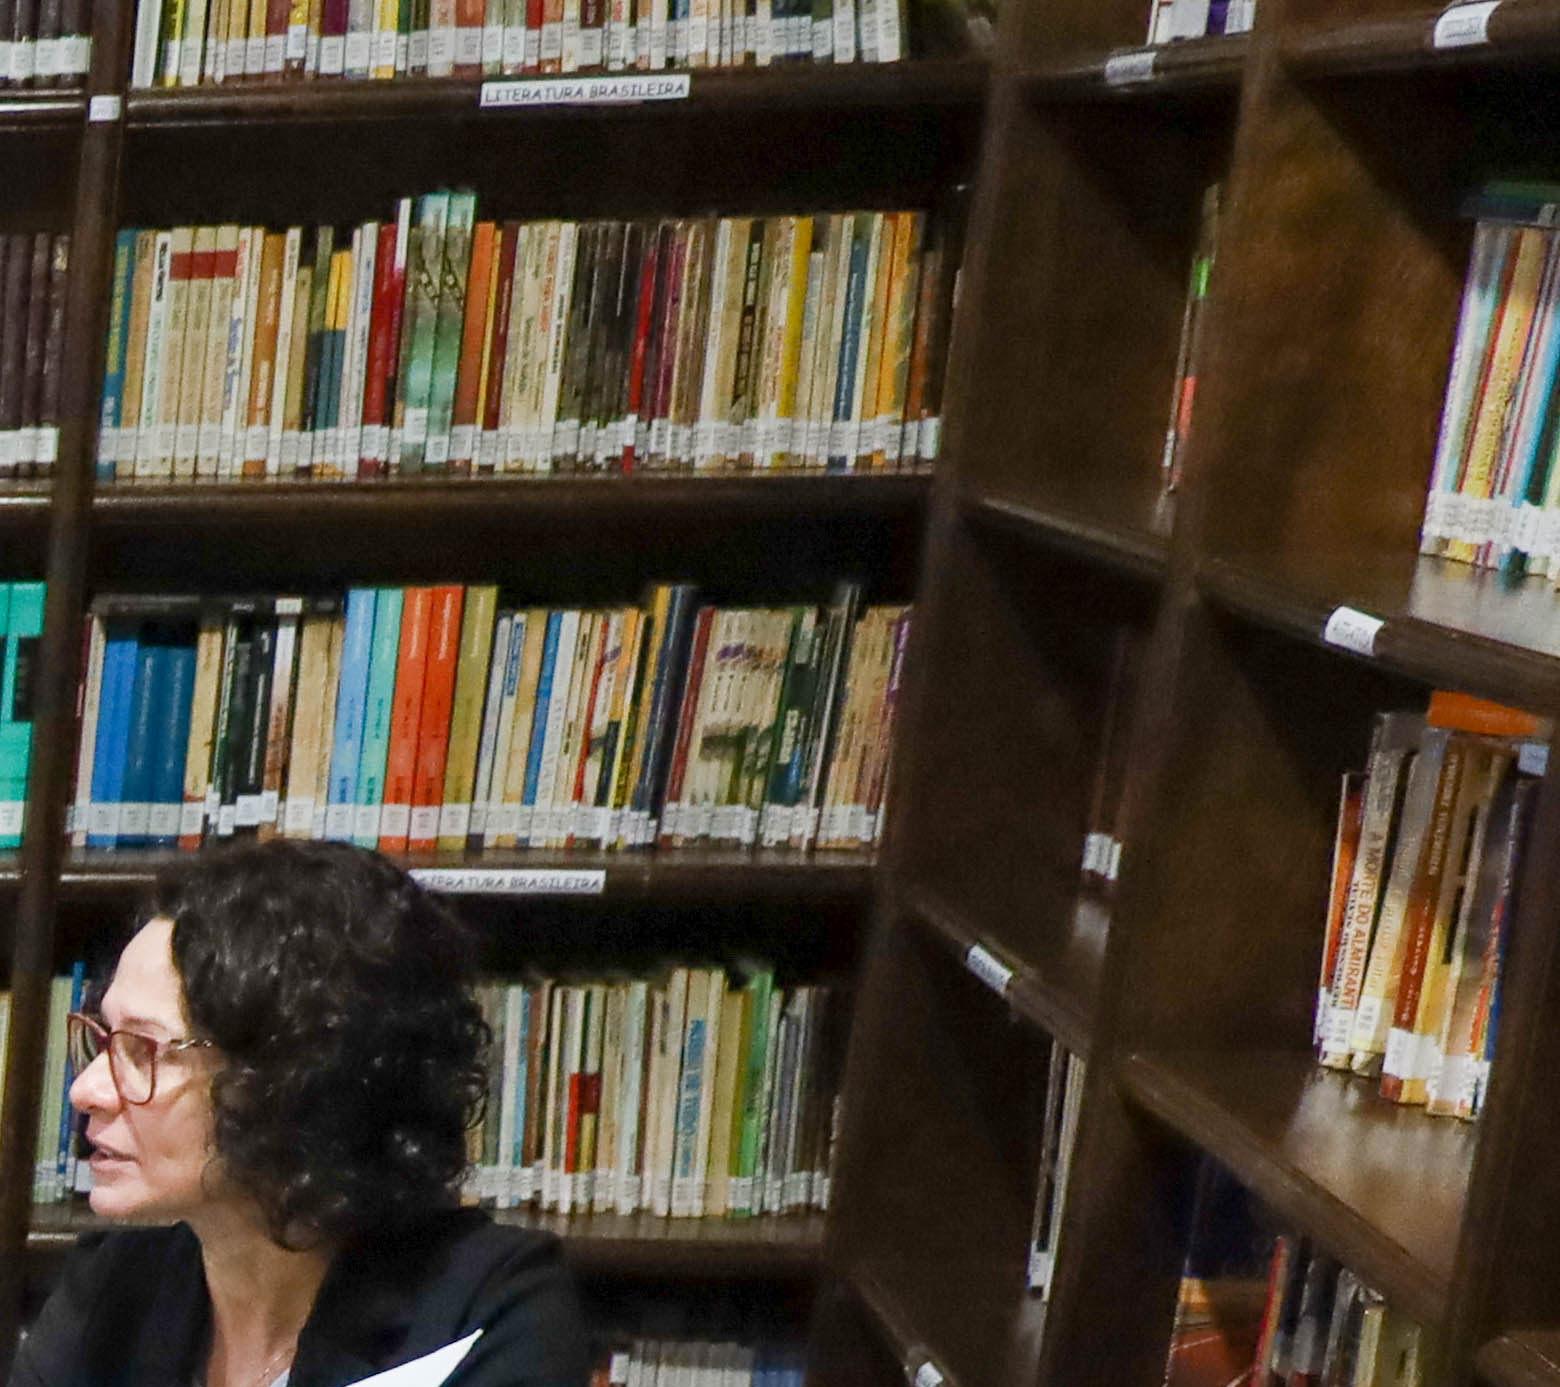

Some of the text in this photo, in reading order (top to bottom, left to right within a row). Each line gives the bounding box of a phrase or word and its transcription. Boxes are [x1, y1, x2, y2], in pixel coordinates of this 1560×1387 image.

[485, 82, 686, 102] LITERATURA BRASILEIRA
[509, 875, 601, 890] BRASILEIRA
[1357, 848, 1381, 899] MORTE
[1357, 903, 1372, 925] DO
[1340, 929, 1370, 1010] ALMIRANT
